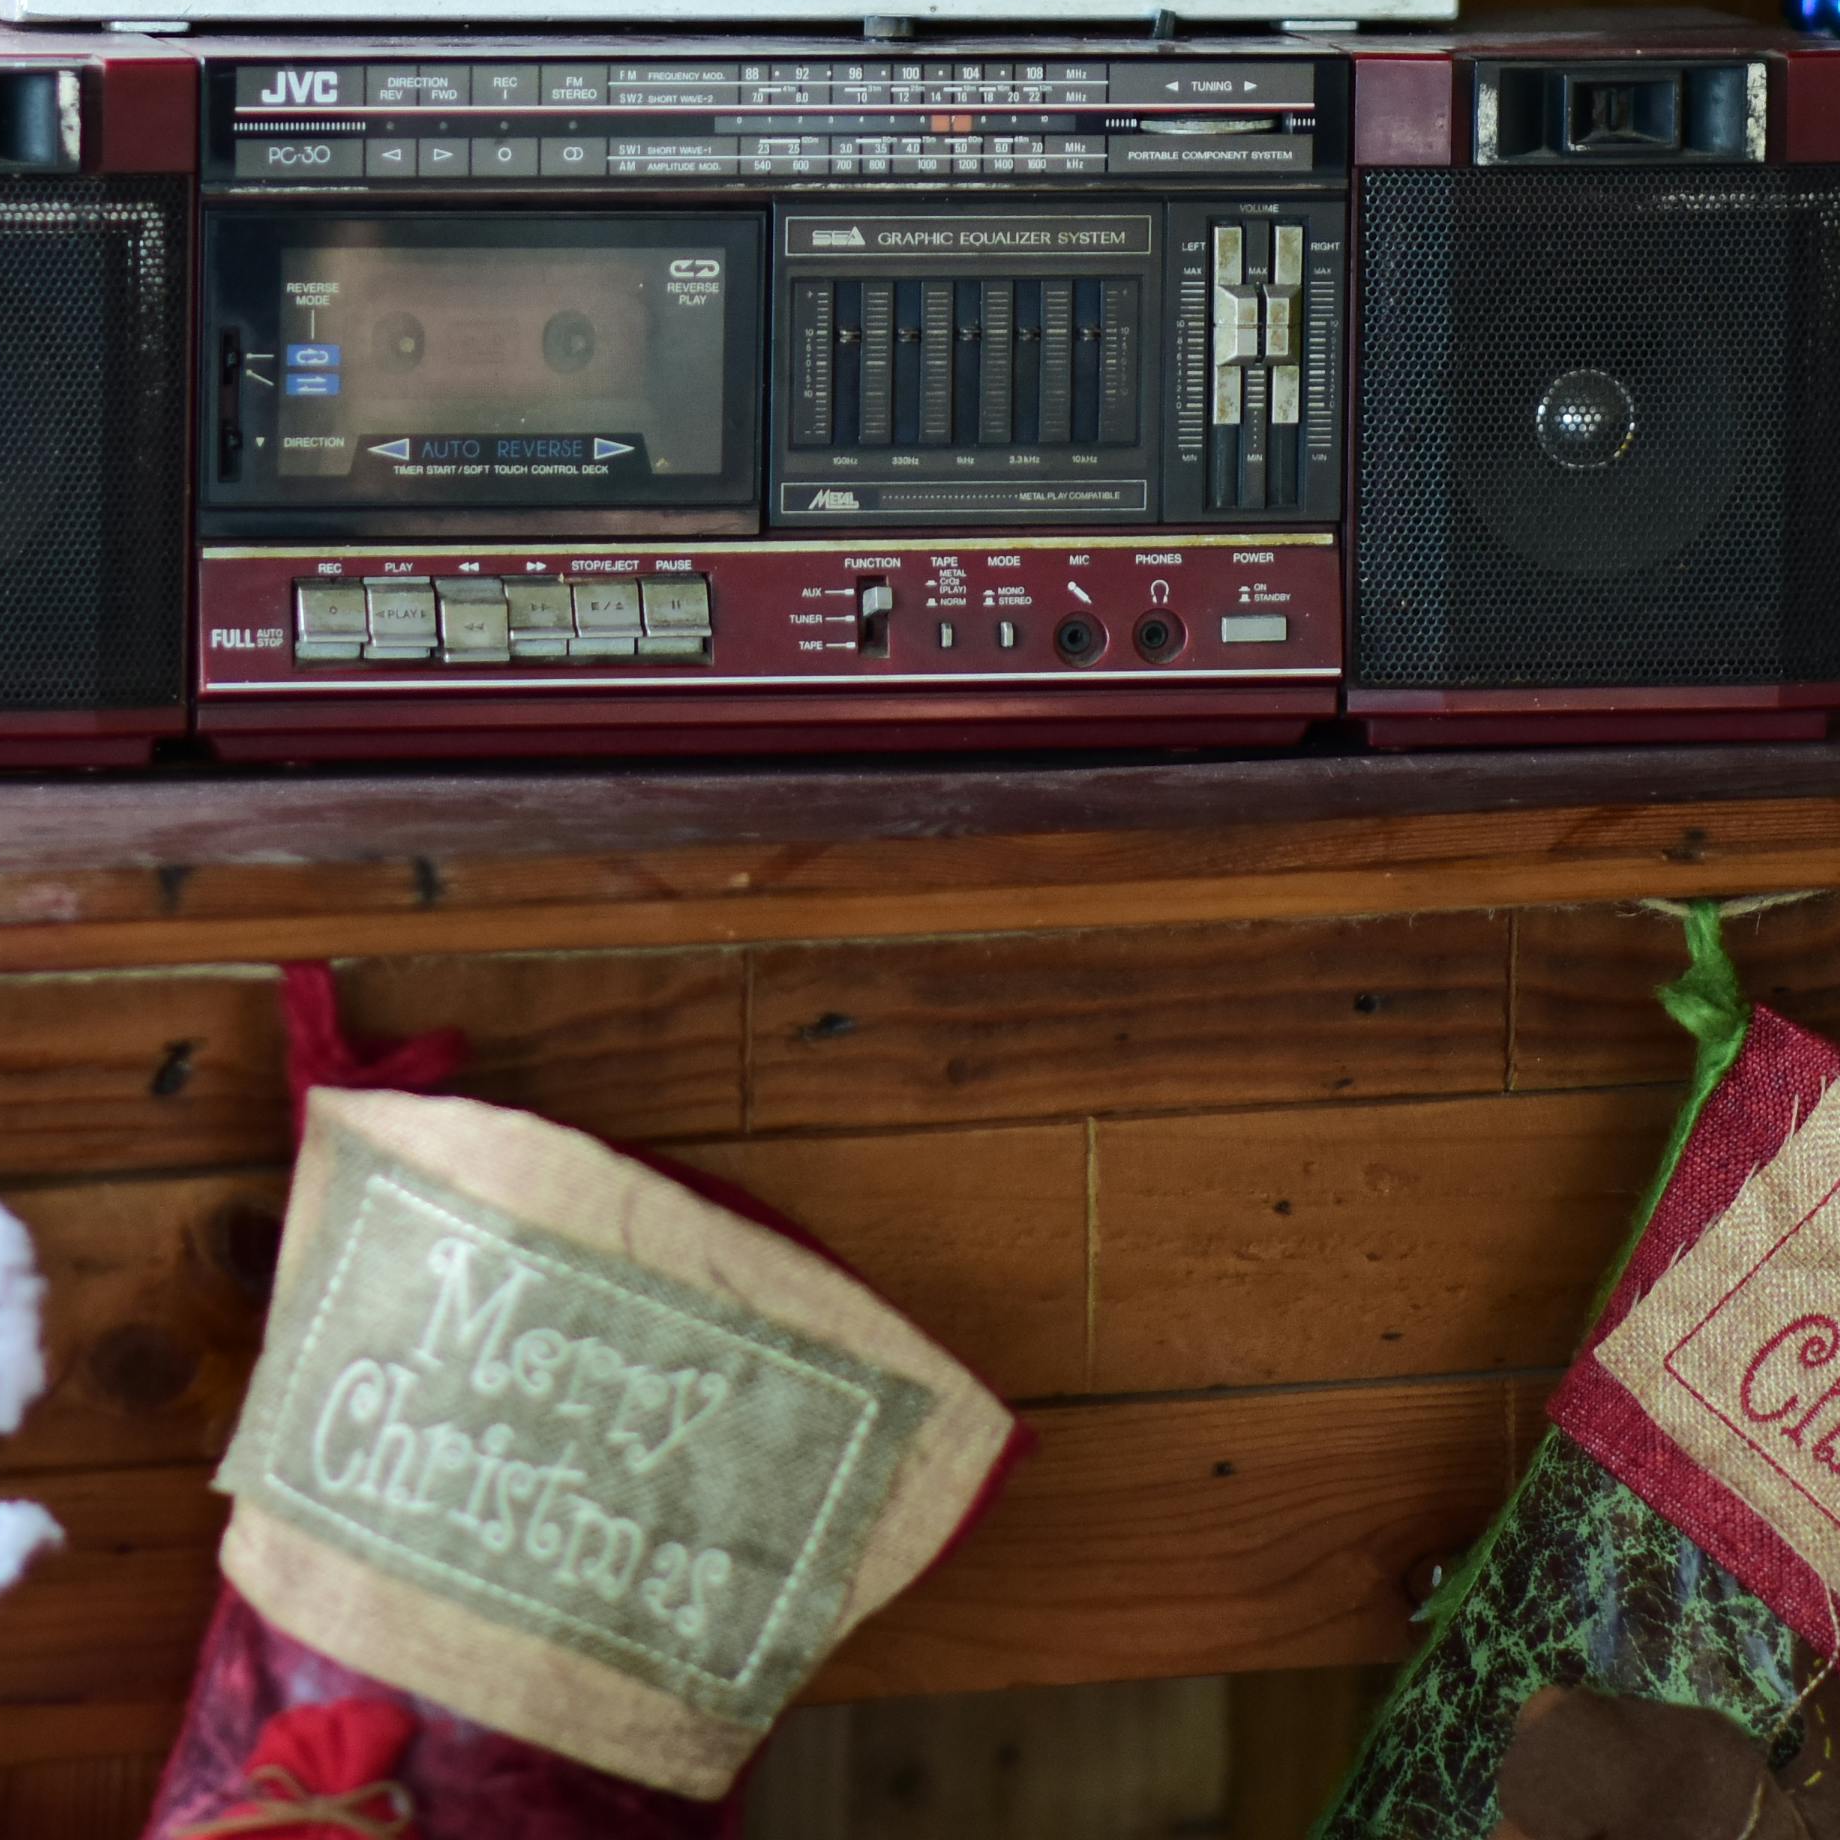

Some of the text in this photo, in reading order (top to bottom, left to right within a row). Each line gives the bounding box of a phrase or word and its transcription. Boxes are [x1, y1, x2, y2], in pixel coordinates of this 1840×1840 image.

[648, 71, 698, 81] FREQUENCY
[700, 71, 726, 81] MOD.
[745, 67, 760, 81] 88
[795, 66, 810, 80] 92
[902, 66, 920, 80] 100
[962, 66, 980, 80] 104
[1026, 66, 1044, 80] 108
[1066, 68, 1087, 80] MHz
[261, 71, 338, 104] JVC
[387, 77, 448, 89] DIRECTION
[493, 77, 518, 88] REC
[565, 77, 583, 88] FM
[1191, 81, 1232, 92] TUNING
[380, 89, 458, 100] REV FWD
[552, 89, 598, 100] STEREO
[619, 90, 1087, 104] SW2 SHORT WAVE-2 10 12 14 16 18 20 22 MHz
[618, 142, 1086, 155] SW1 SHORT WAVE-1 MHz
[268, 146, 332, 165] PC-30
[1128, 151, 1293, 160] PORTABLE COMPONENT SYSTEM
[619, 161, 636, 172] AM
[647, 161, 695, 171] AMPLITUDE
[697, 161, 722, 171] MOD.
[754, 159, 771, 171] 540
[793, 159, 809, 171] 600
[836, 158, 852, 170] 700
[869, 158, 886, 170] 800
[958, 158, 978, 170] 1200
[993, 158, 1014, 170] 1400
[1065, 158, 1084, 170] kHz
[1239, 203, 1280, 213] VOLUME
[812, 226, 1126, 247] SEA GRAPHIC EQUALIZER SYSTEM
[1181, 242, 1206, 252] LEFT
[1310, 241, 1341, 252] RIGHT
[286, 283, 340, 294] REVERSE
[667, 283, 720, 293] REVERSE
[295, 295, 331, 306] MODE
[679, 295, 708, 306] PLAY
[284, 437, 346, 448] DIRECTION
[421, 439, 584, 459] AUTO REVERSE
[394, 465, 424, 475] TIMER
[494, 464, 528, 475] TOUCH
[531, 464, 579, 475] CONTROL
[582, 464, 609, 474] DECK
[808, 488, 860, 510] METAL
[1019, 491, 1120, 501] METAL PLAY COMPATIBLE
[844, 557, 901, 569] FUNCTION
[930, 556, 959, 567] TAPE
[987, 555, 1021, 567] MODE
[1069, 555, 1090, 566] MIC
[1135, 553, 1183, 565] PHONES
[1233, 552, 1275, 564] POWER
[318, 563, 343, 574] REC
[384, 562, 413, 573] PLAY
[571, 560, 640, 573] STOP/EJECT
[655, 559, 693, 571] PAUSE
[939, 569, 967, 578] METAL
[802, 587, 823, 598] AUX
[997, 586, 1025, 595] MONO
[1254, 583, 1268, 591] ON
[940, 597, 967, 606] NORM
[998, 596, 1033, 605] STEREO
[1254, 593, 1291, 602] STANDBY
[789, 614, 823, 625] TUNER
[211, 628, 255, 648] FULL
[257, 628, 284, 638] AUTO
[257, 638, 284, 648] STOP
[798, 640, 823, 651] TAPE
[412, 1236, 729, 1472] Merry
[312, 1358, 732, 1636] Christmas
